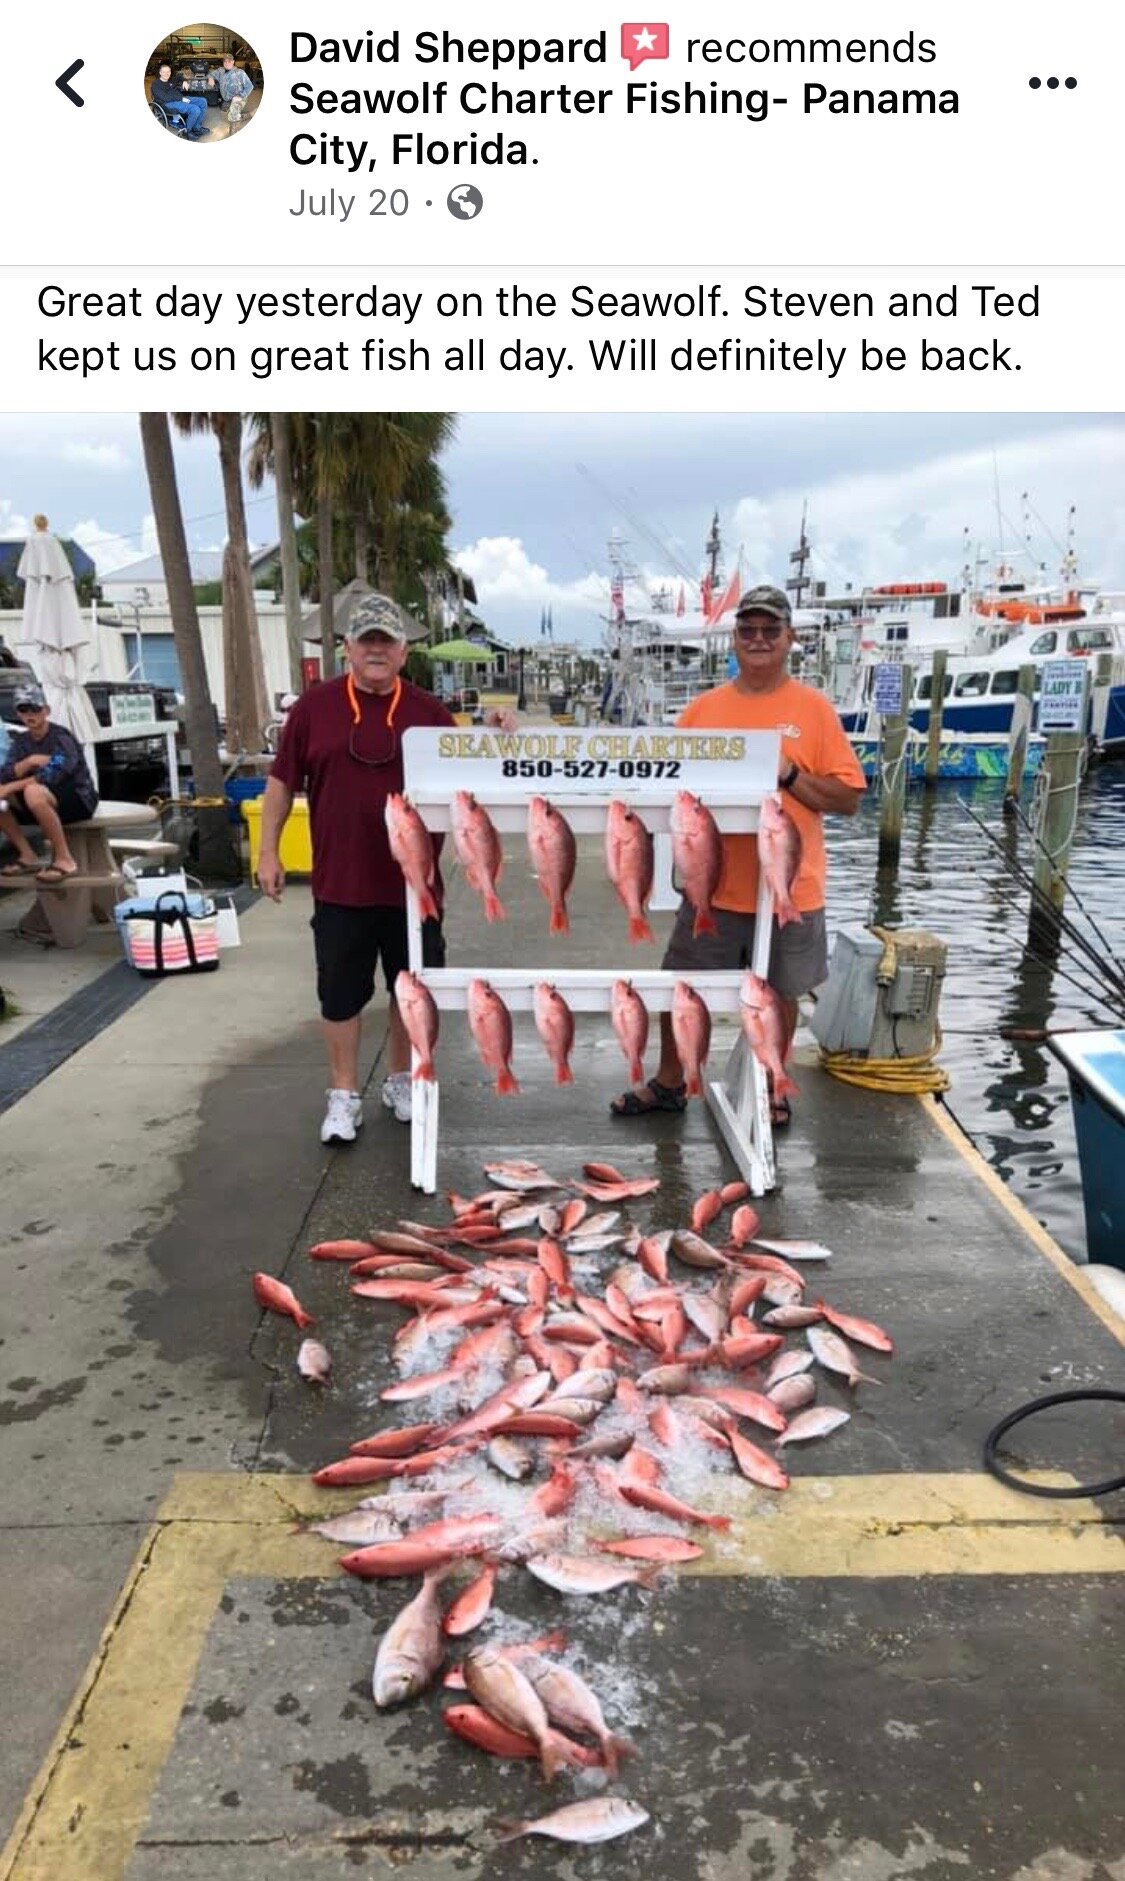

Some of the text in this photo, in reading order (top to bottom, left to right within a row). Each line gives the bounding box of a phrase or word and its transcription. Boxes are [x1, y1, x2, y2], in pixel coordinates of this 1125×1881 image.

[438, 735, 747, 761] SEAWOLF CHARTERS
[502, 760, 681, 779] 850-527-0972
